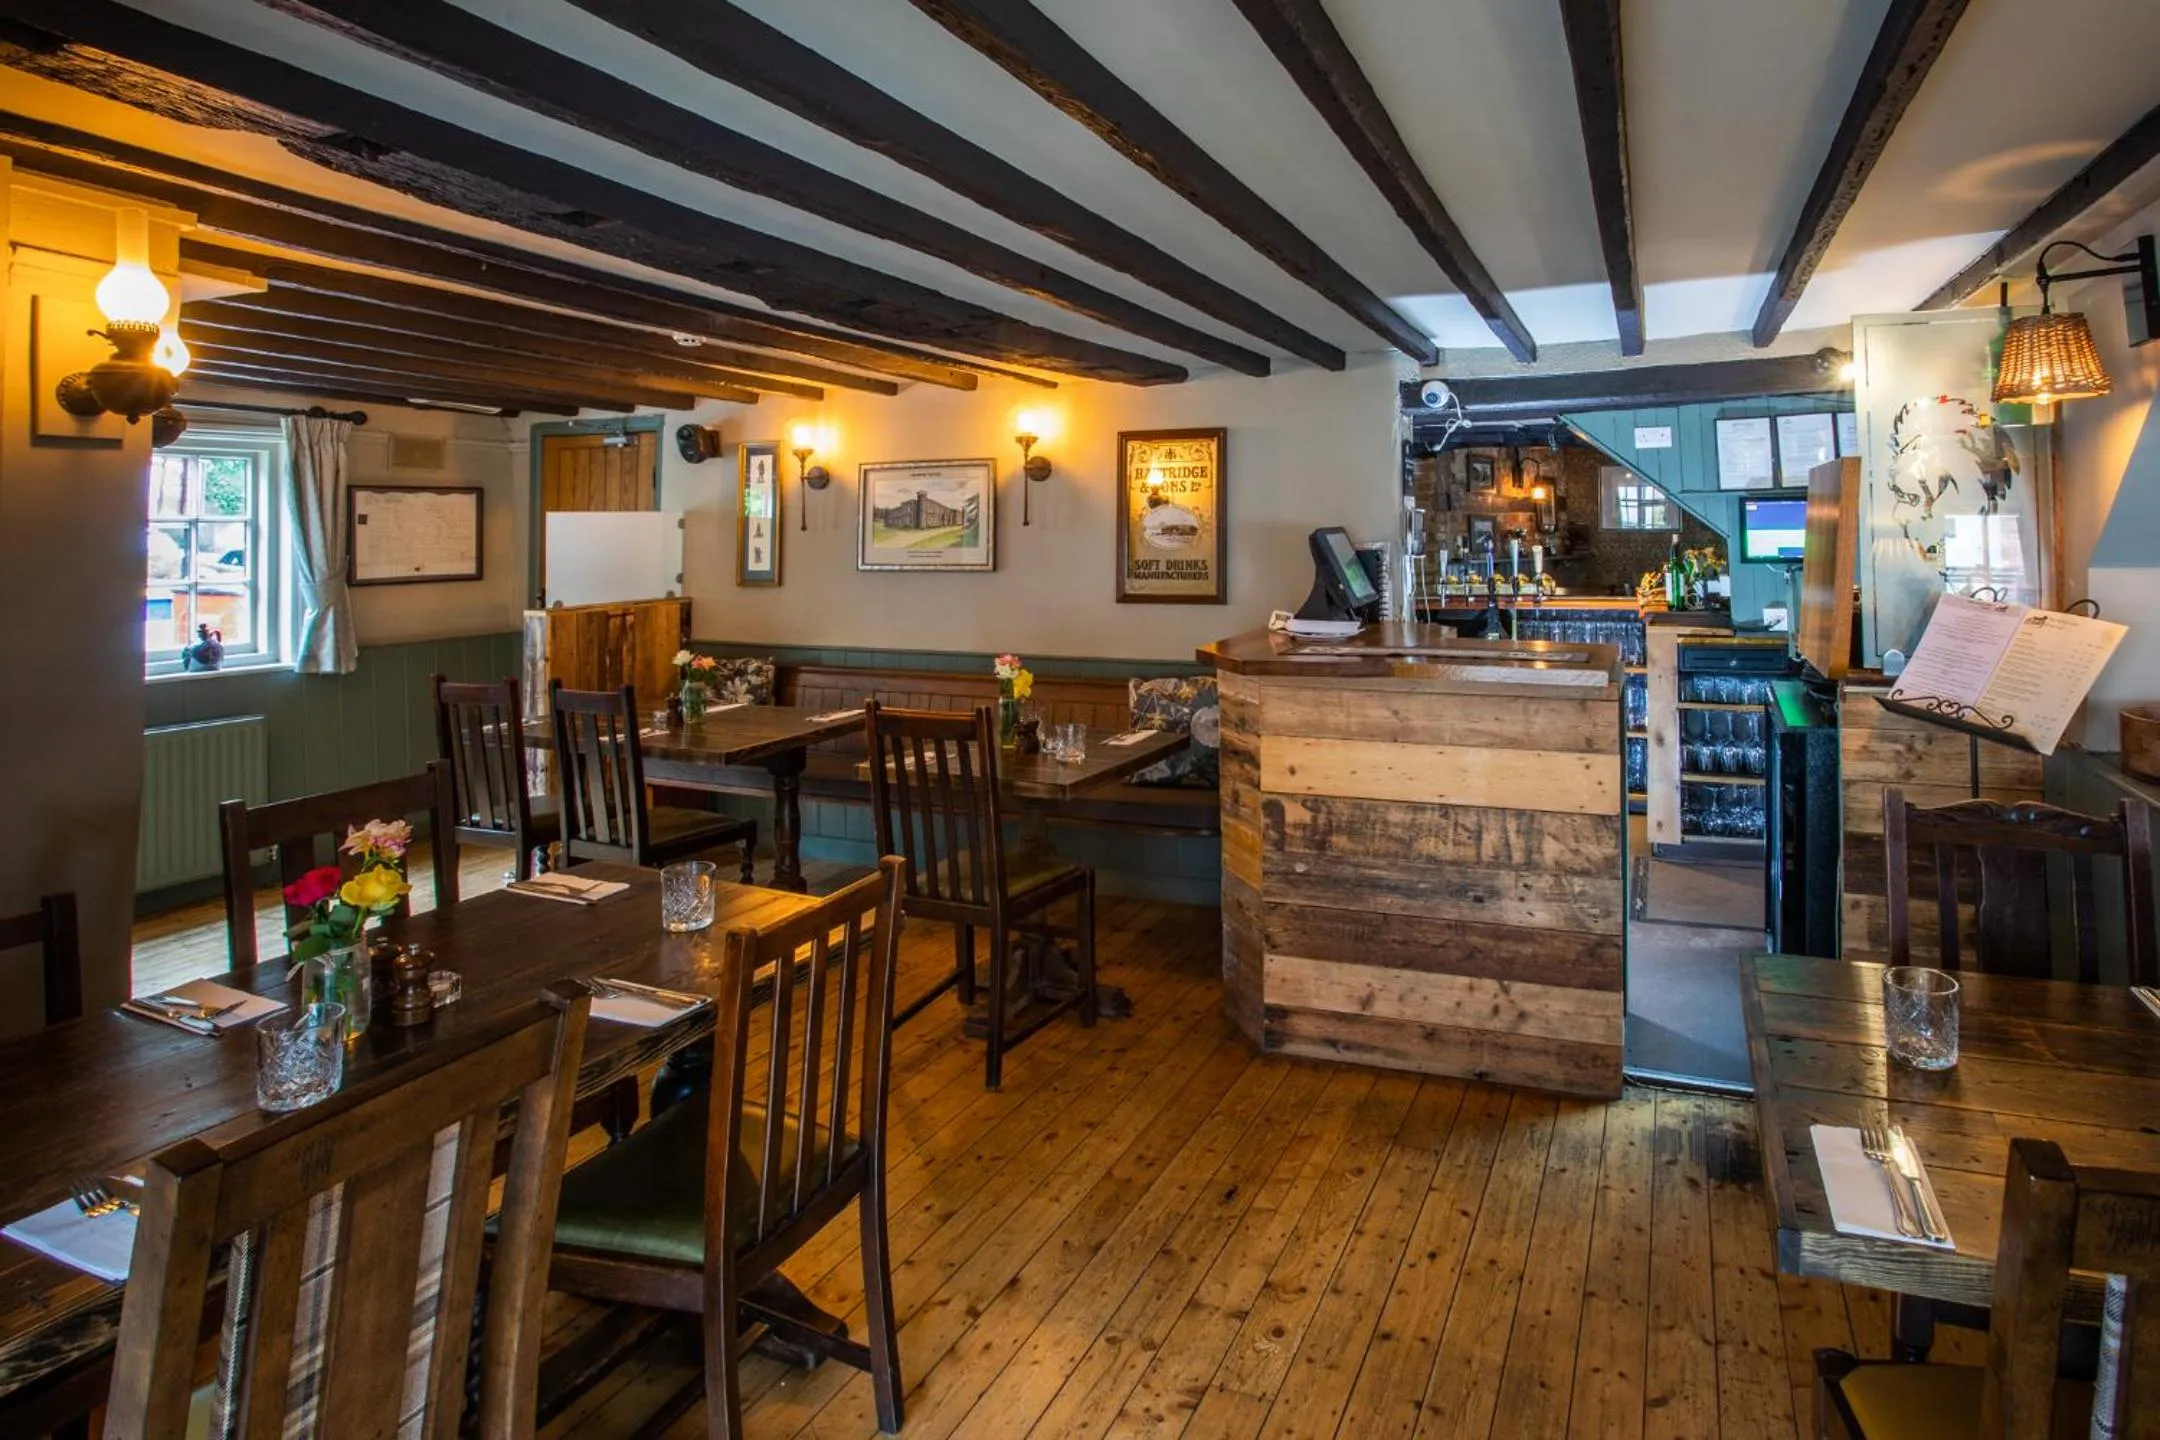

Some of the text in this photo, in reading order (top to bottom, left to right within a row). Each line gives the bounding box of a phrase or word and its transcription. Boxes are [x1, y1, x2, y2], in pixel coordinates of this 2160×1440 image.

[1135, 465, 1208, 480] HTRIDGE
[1140, 481, 1150, 493] &
[1151, 480, 1187, 493] ONS
[1134, 559, 1209, 571] SOFT DRINKS
[1134, 571, 1209, 581] MANUFACTURERS
